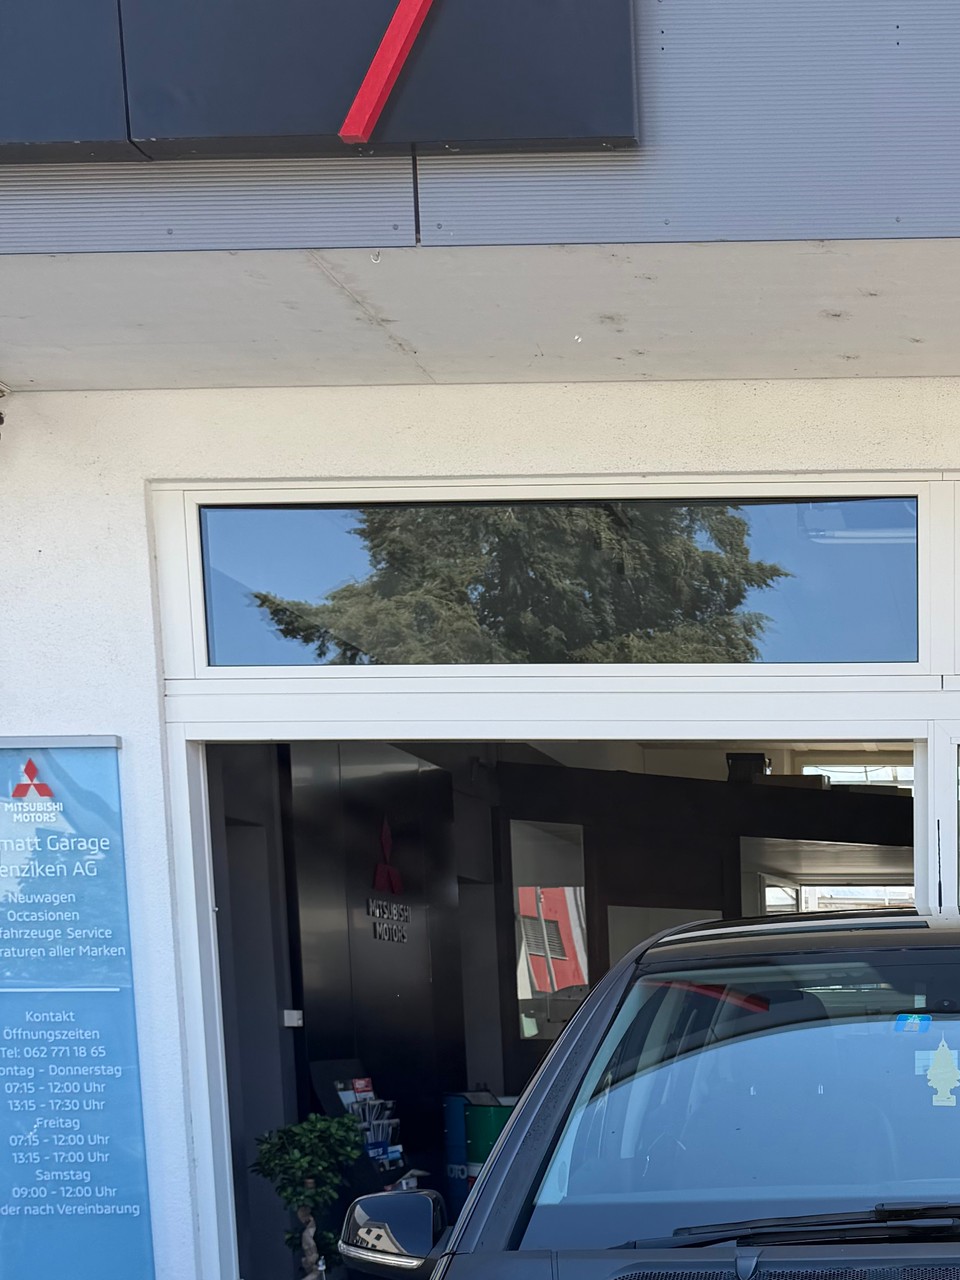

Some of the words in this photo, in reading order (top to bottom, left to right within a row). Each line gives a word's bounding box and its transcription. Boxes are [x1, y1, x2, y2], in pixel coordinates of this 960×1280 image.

[4, 802, 63, 812] MITSUBISHI
[13, 813, 57, 823] MOTORS
[0, 836, 42, 851] matt
[46, 835, 110, 854] Garage
[0, 861, 67, 877] enziken
[72, 861, 98, 877] AG
[8, 893, 76, 906] Neuwagen
[7, 910, 80, 922] Occasionen
[368, 898, 412, 924] MITSUBISHI
[0, 927, 62, 941] fahrzeuge
[66, 927, 113, 939] Service
[375, 922, 408, 943] MOTORS
[0, 947, 46, 958] raturen
[48, 946, 76, 958] aller
[79, 944, 126, 957] Marken
[25, 1011, 76, 1022] Kontakt
[3, 1026, 100, 1043] Öffnungszeiten
[23, 1046, 48, 1058] 062
[90, 1045, 107, 1057] 65
[0, 1065, 35, 1079] ontag
[48, 1064, 122, 1078] Donnerstag
[4, 1082, 35, 1095] 07:15
[47, 1082, 81, 1093] 12:00
[83, 1081, 106, 1093] Uhr
[48, 1099, 80, 1111] 17:30
[83, 1099, 106, 1110] Uhr
[36, 1117, 81, 1131] Freitag
[52, 1134, 85, 1146] 12:00
[87, 1134, 111, 1145] Uhr
[53, 1151, 85, 1163] 17:00
[87, 1151, 111, 1163] Uhr
[35, 1169, 91, 1183] Samstag
[12, 1186, 48, 1198] 09:00
[60, 1186, 93, 1198] 12:00
[95, 1186, 118, 1197] Uhr
[0, 1204, 21, 1216] der
[24, 1203, 55, 1216] nach
[56, 1202, 141, 1217] Vereinbarung
